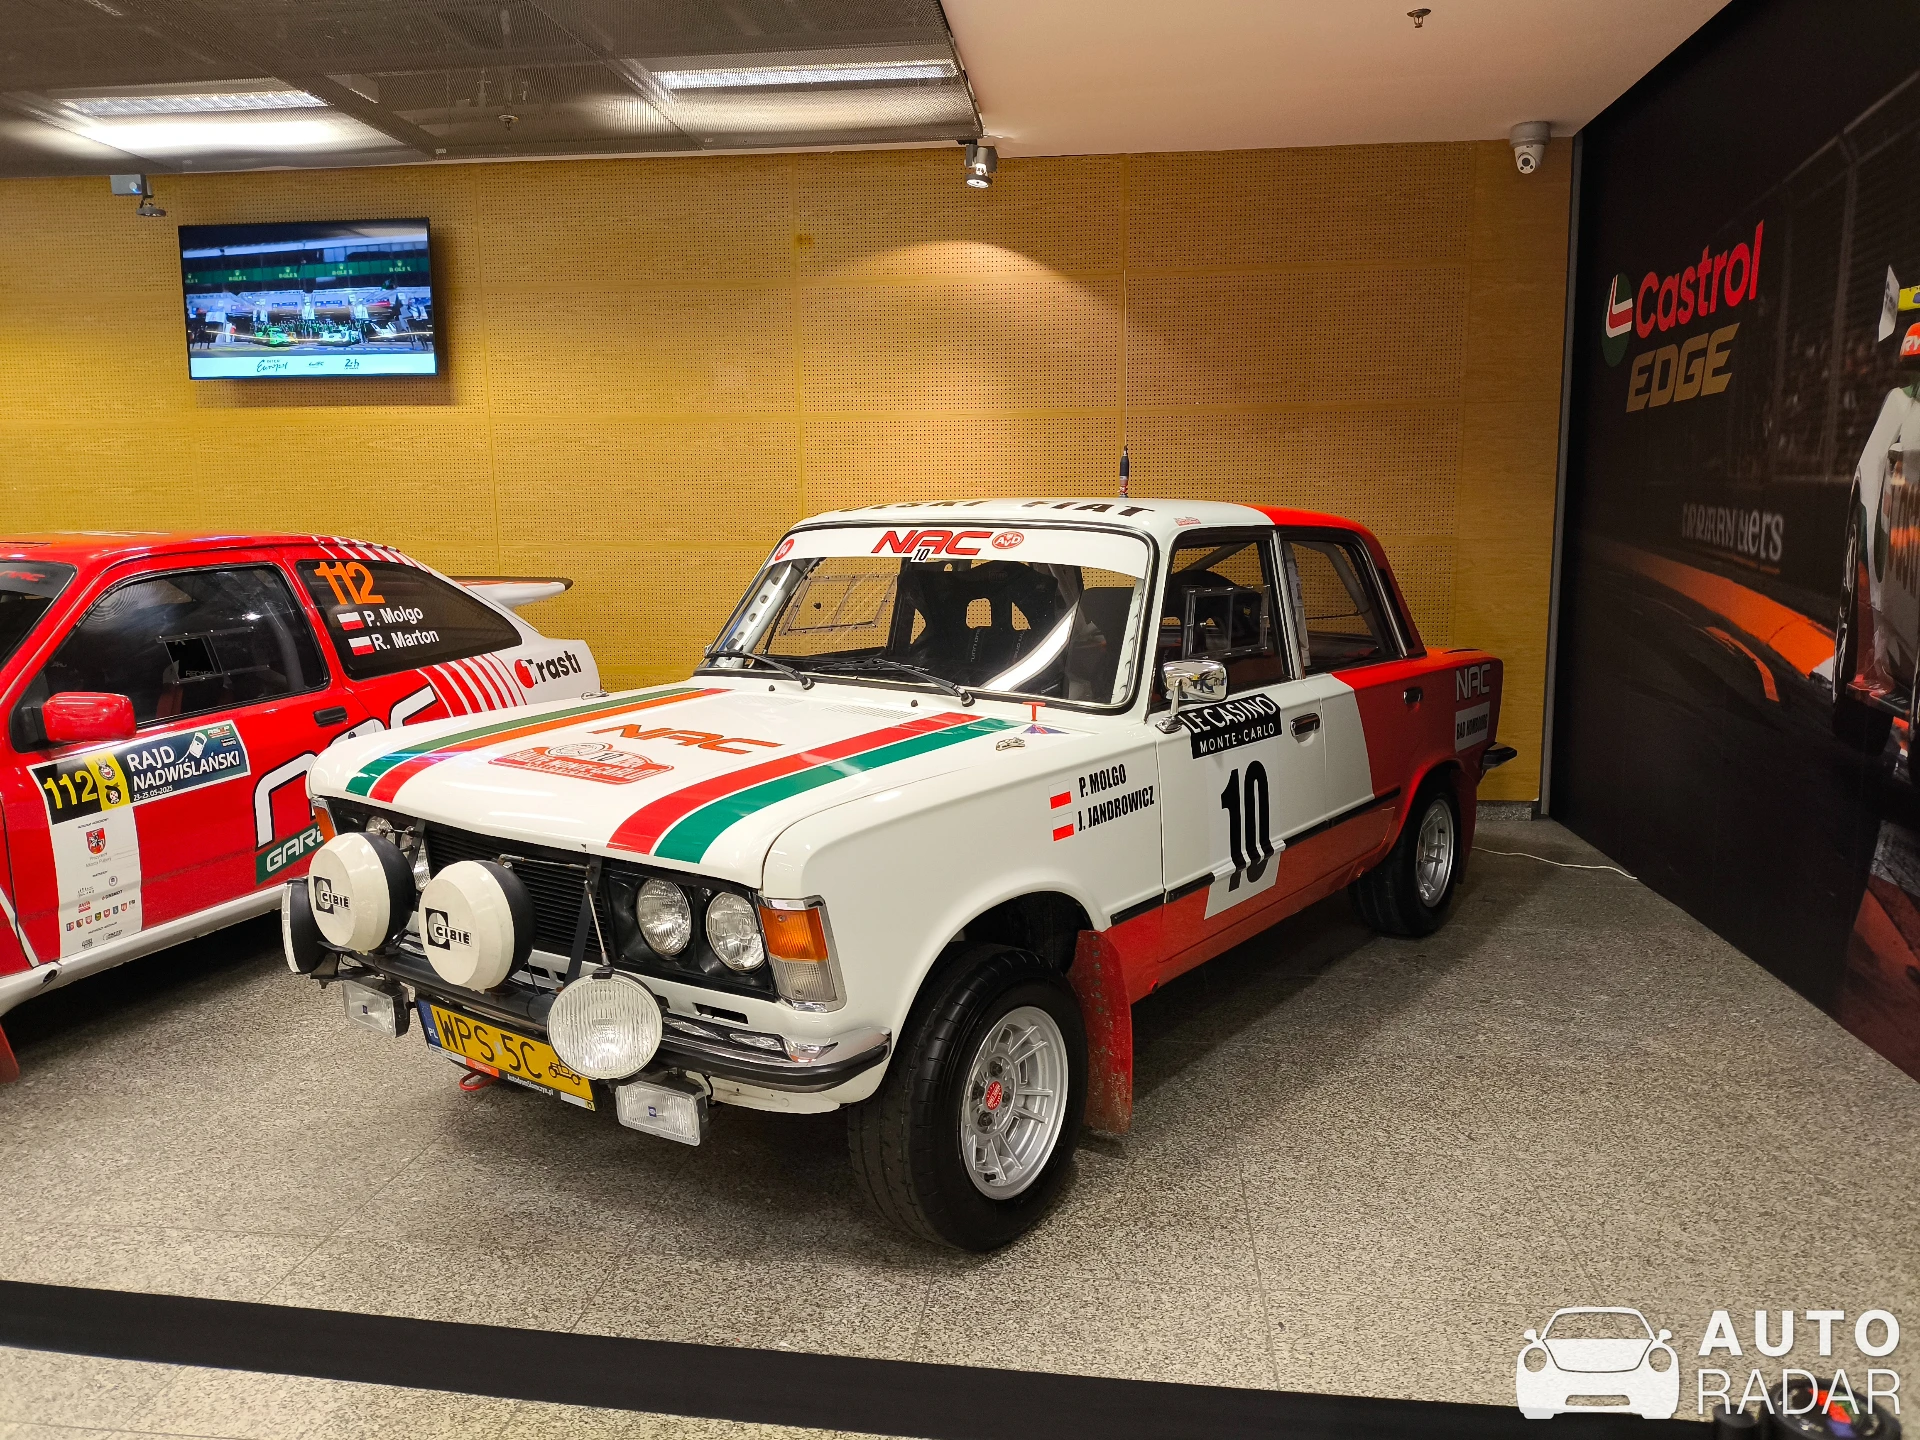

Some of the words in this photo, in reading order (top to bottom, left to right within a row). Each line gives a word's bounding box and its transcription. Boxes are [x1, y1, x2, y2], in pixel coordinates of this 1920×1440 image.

[1635, 219, 1764, 339] Castrol
[1626, 322, 1740, 413] EDGE
[1020, 500, 1156, 517] FIAT
[871, 529, 994, 555] NAC
[913, 548, 931, 562] 10
[313, 561, 386, 605] 112
[362, 610, 381, 627] P.
[380, 605, 424, 625] Molgo
[371, 633, 391, 651] R.
[391, 629, 440, 649] Marton
[515, 650, 582, 688] Trasti
[1455, 663, 1491, 701] NAC
[1177, 712, 1211, 734] LE
[1203, 696, 1277, 728] CASINO
[587, 724, 786, 755] NAC
[126, 745, 175, 772] RAJD
[43, 769, 98, 810] 112
[132, 750, 240, 792] NADWIŚLAŃSKI
[1078, 776, 1088, 798] P.
[1088, 763, 1127, 794] MOLGO
[1077, 810, 1086, 832] J.
[1087, 785, 1155, 829] JANDROWICZ
[1220, 759, 1275, 893] 10
[322, 891, 349, 907] CIBIÉ
[435, 926, 470, 945] CIBIÉ
[428, 1027, 439, 1040] PL
[436, 1010, 495, 1063] WPS
[500, 1033, 543, 1079] 5C
